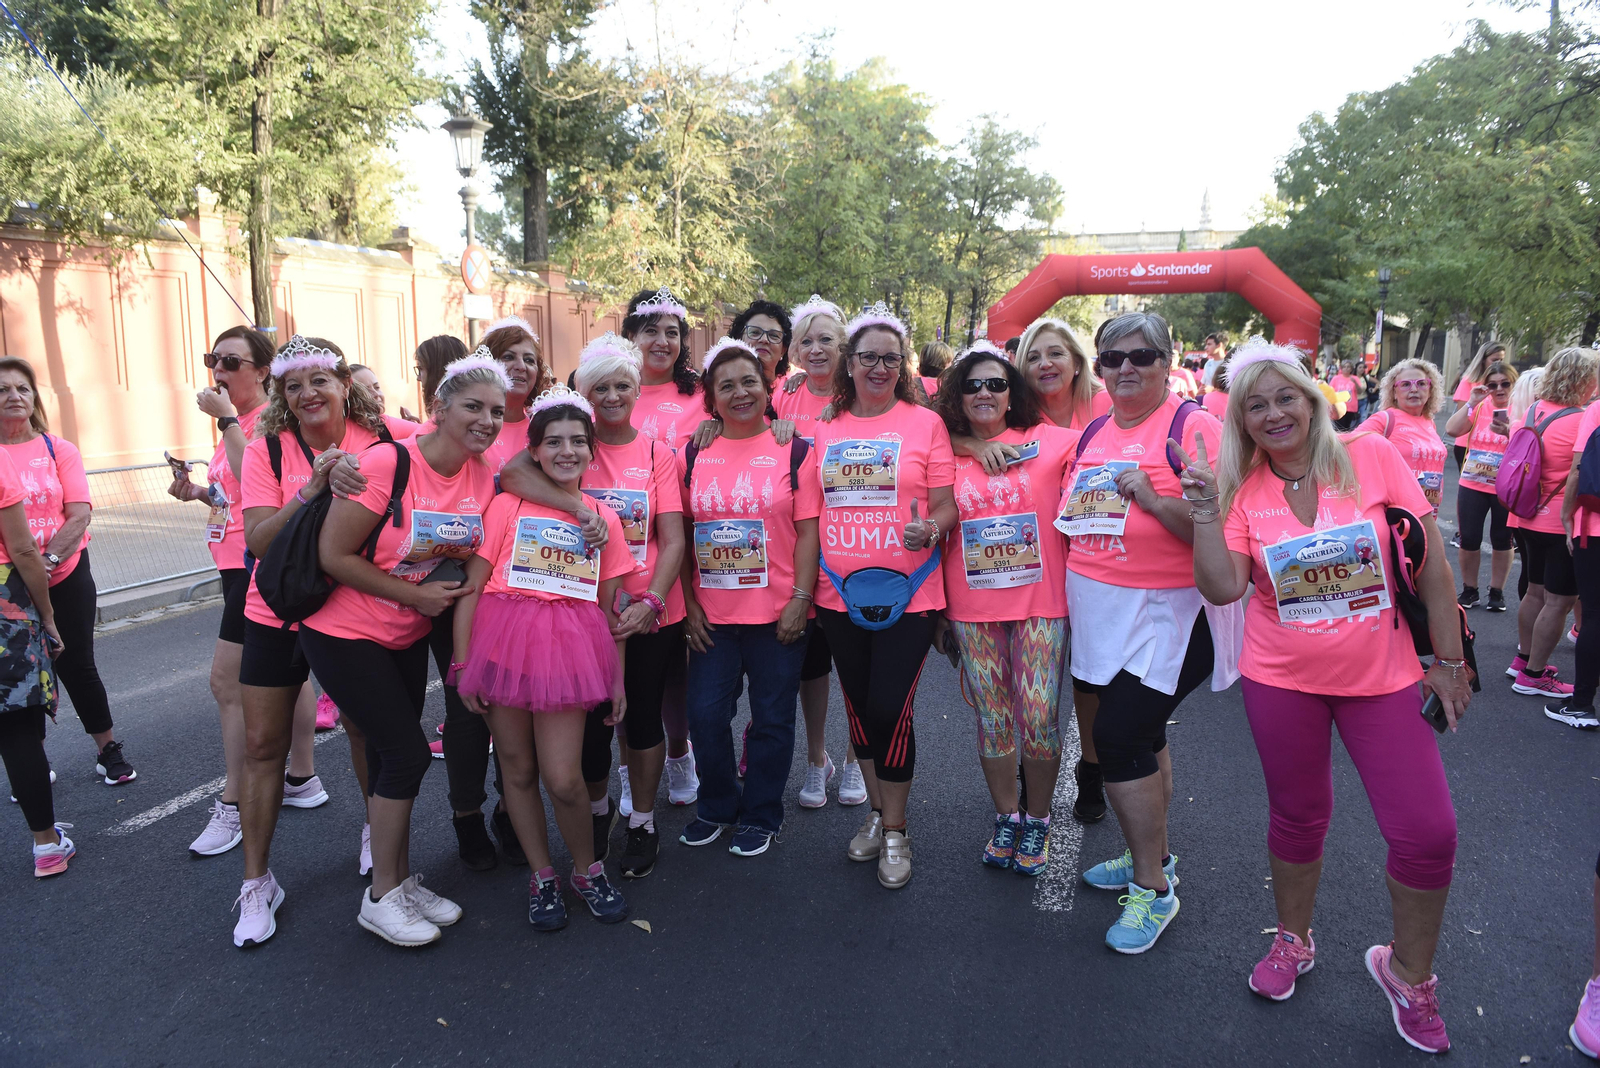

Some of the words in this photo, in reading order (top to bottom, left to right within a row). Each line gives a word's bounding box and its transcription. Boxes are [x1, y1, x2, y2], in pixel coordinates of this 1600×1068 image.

[1090, 265, 1129, 280] Sports
[1147, 262, 1212, 276] Santander
[784, 412, 810, 421] OYSHO
[695, 457, 726, 465] OYSHO
[842, 464, 873, 477] 016
[1475, 463, 1493, 472] 016
[828, 495, 848, 503] OYSHO
[1080, 489, 1107, 504] 016
[1425, 489, 1438, 497] 016
[826, 510, 839, 522] TU
[843, 511, 901, 524] DORSAL
[1249, 507, 1290, 519] OYSHO
[29, 517, 59, 528] RSAL
[543, 530, 578, 544] ASTURIANA
[826, 524, 902, 550] SUMA
[983, 530, 1014, 538] ASTURIANA
[540, 545, 575, 565] 016
[712, 547, 742, 560] 016
[984, 543, 1017, 558] 016
[1300, 547, 1345, 561] ASTURIANA
[1273, 553, 1291, 562] SUMA
[547, 563, 566, 573] 5357
[1303, 563, 1349, 583] 016
[516, 576, 545, 585] OYSHO
[529, 567, 551, 576] CARRERA
[564, 574, 580, 582] MUJER
[566, 585, 590, 594] Santander
[1318, 583, 1342, 594] 4745
[1298, 594, 1325, 603] CARRERA
[1325, 593, 1334, 601] DE
[1343, 589, 1364, 598] MUJER
[1357, 598, 1376, 606] Santander
[375, 597, 399, 611] CARRERA
[1288, 606, 1322, 616] OYSHO
